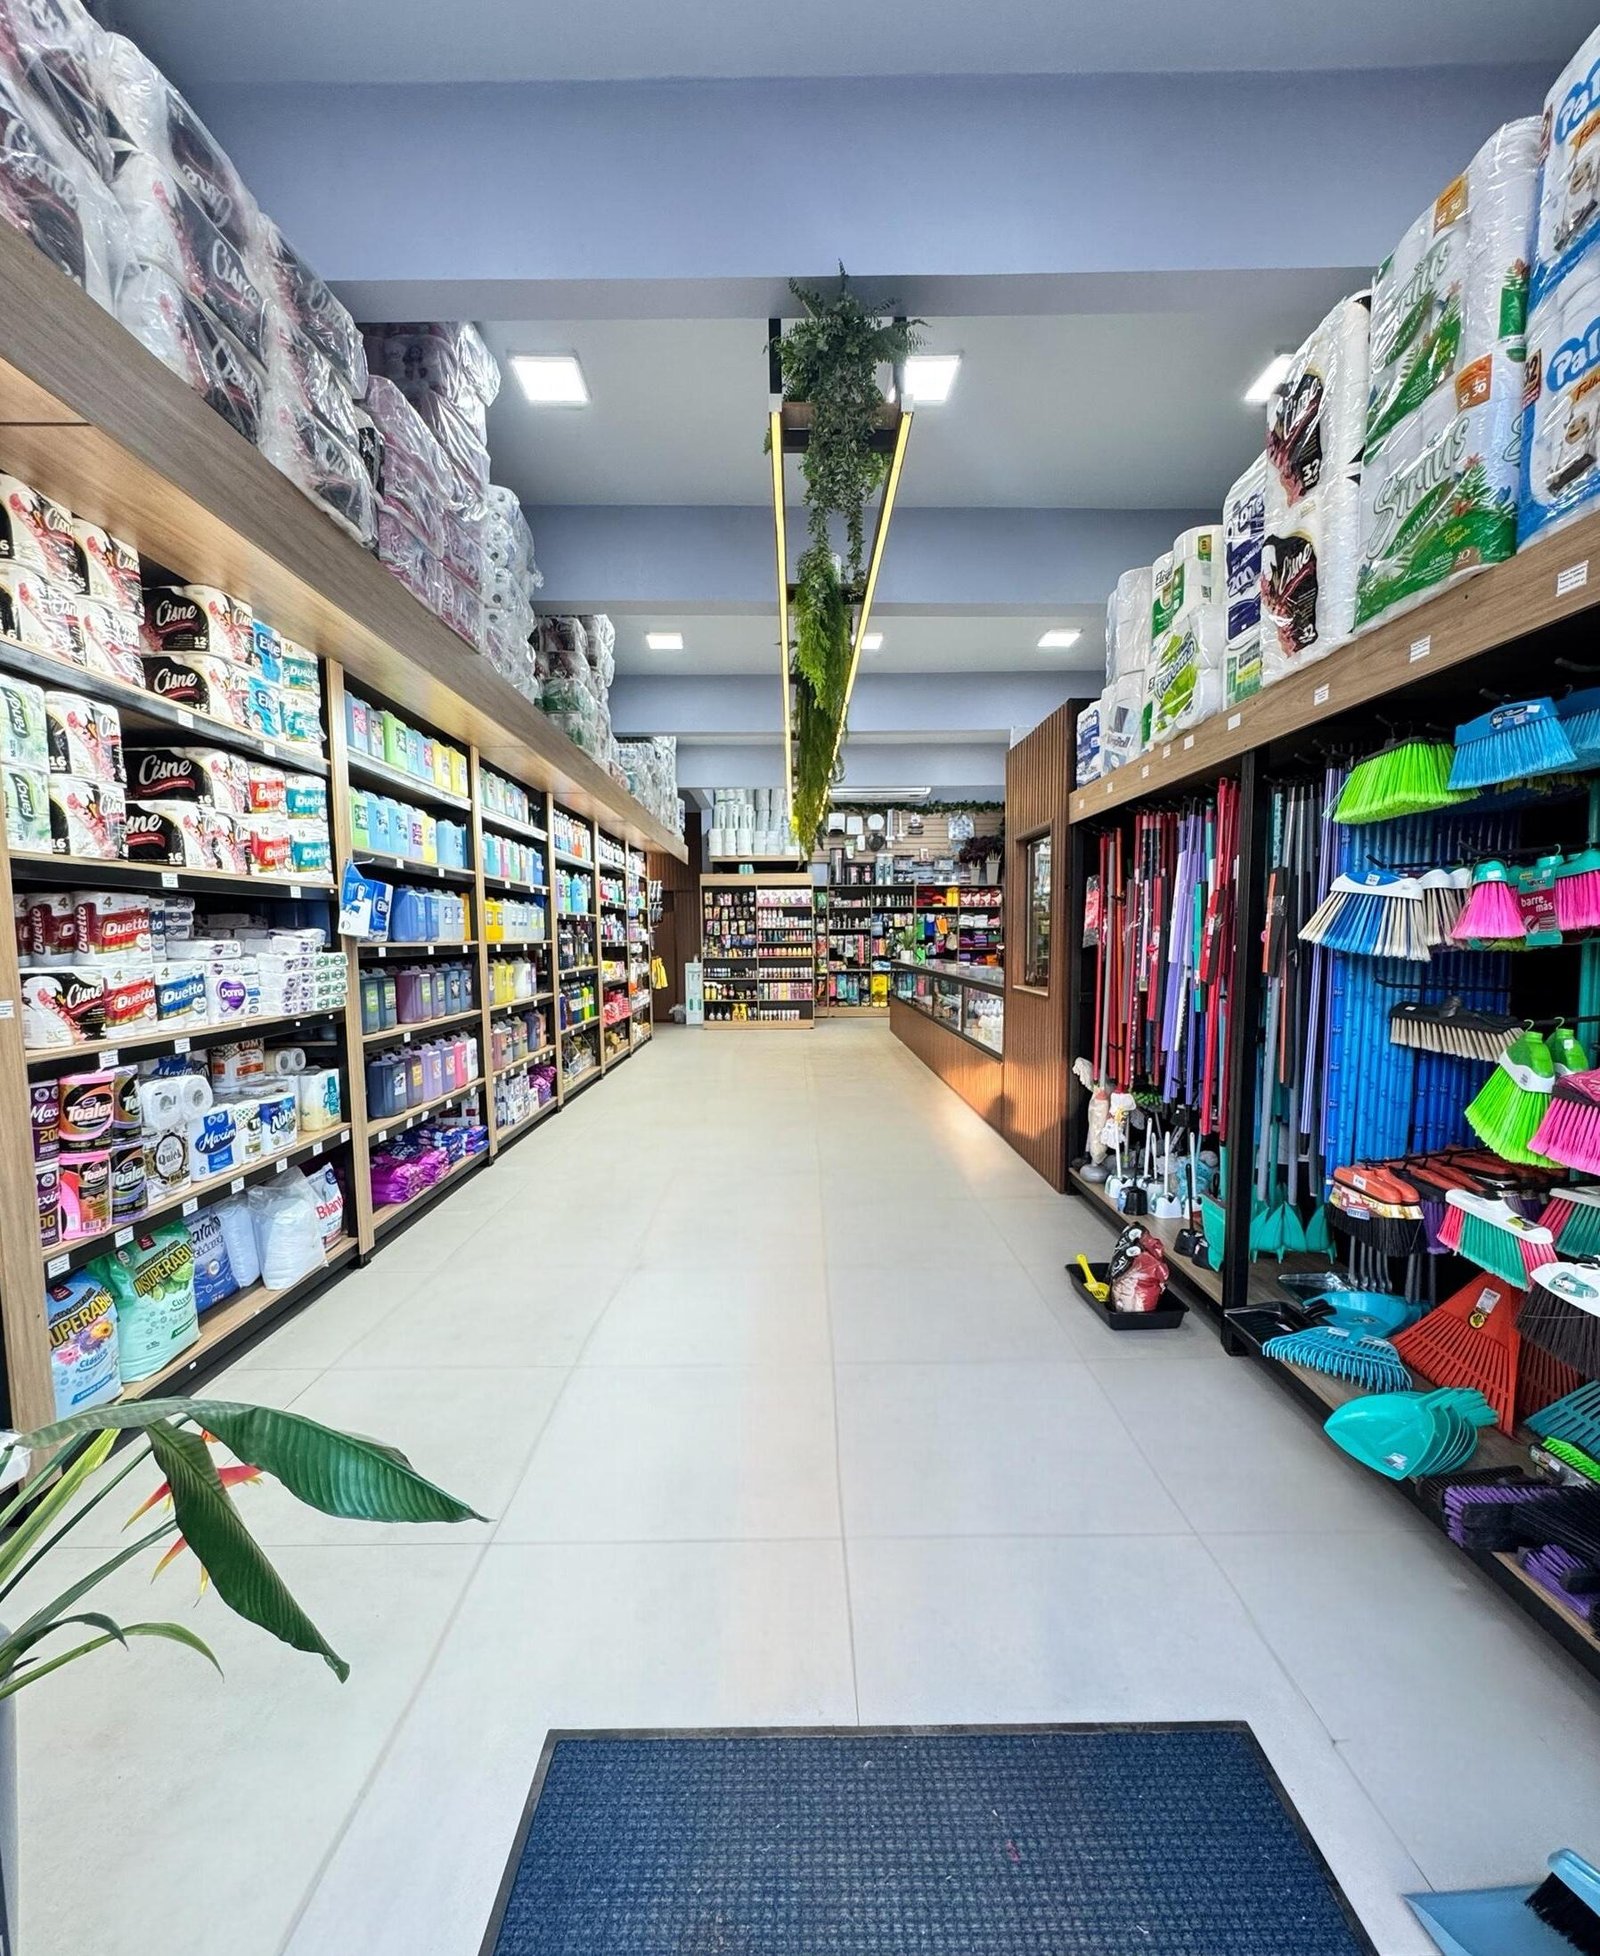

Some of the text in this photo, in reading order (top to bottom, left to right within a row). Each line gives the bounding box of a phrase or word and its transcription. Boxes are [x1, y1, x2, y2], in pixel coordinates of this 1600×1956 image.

[157, 600, 197, 627] Cisne
[154, 669, 197, 694] Cisne
[50, 756, 67, 766] 16
[139, 755, 192, 785] Cisne
[16, 778, 34, 818] Fancy
[198, 796, 212, 804] 16
[168, 853, 183, 861] 16
[58, 897, 69, 909] 4
[103, 896, 113, 908] 4
[1521, 894, 1545, 908] barre
[1535, 898, 1554, 913] más
[33, 908, 45, 953] Duetto
[78, 905, 89, 954] Duetto
[104, 918, 149, 935] Duetto
[114, 970, 123, 981] 4
[161, 967, 169, 978] 4
[67, 984, 103, 1008] Cisne
[117, 988, 155, 1009] Duetto
[163, 982, 205, 1002] Duetto
[220, 988, 245, 999] Donna
[158, 1150, 183, 1165] Quick
